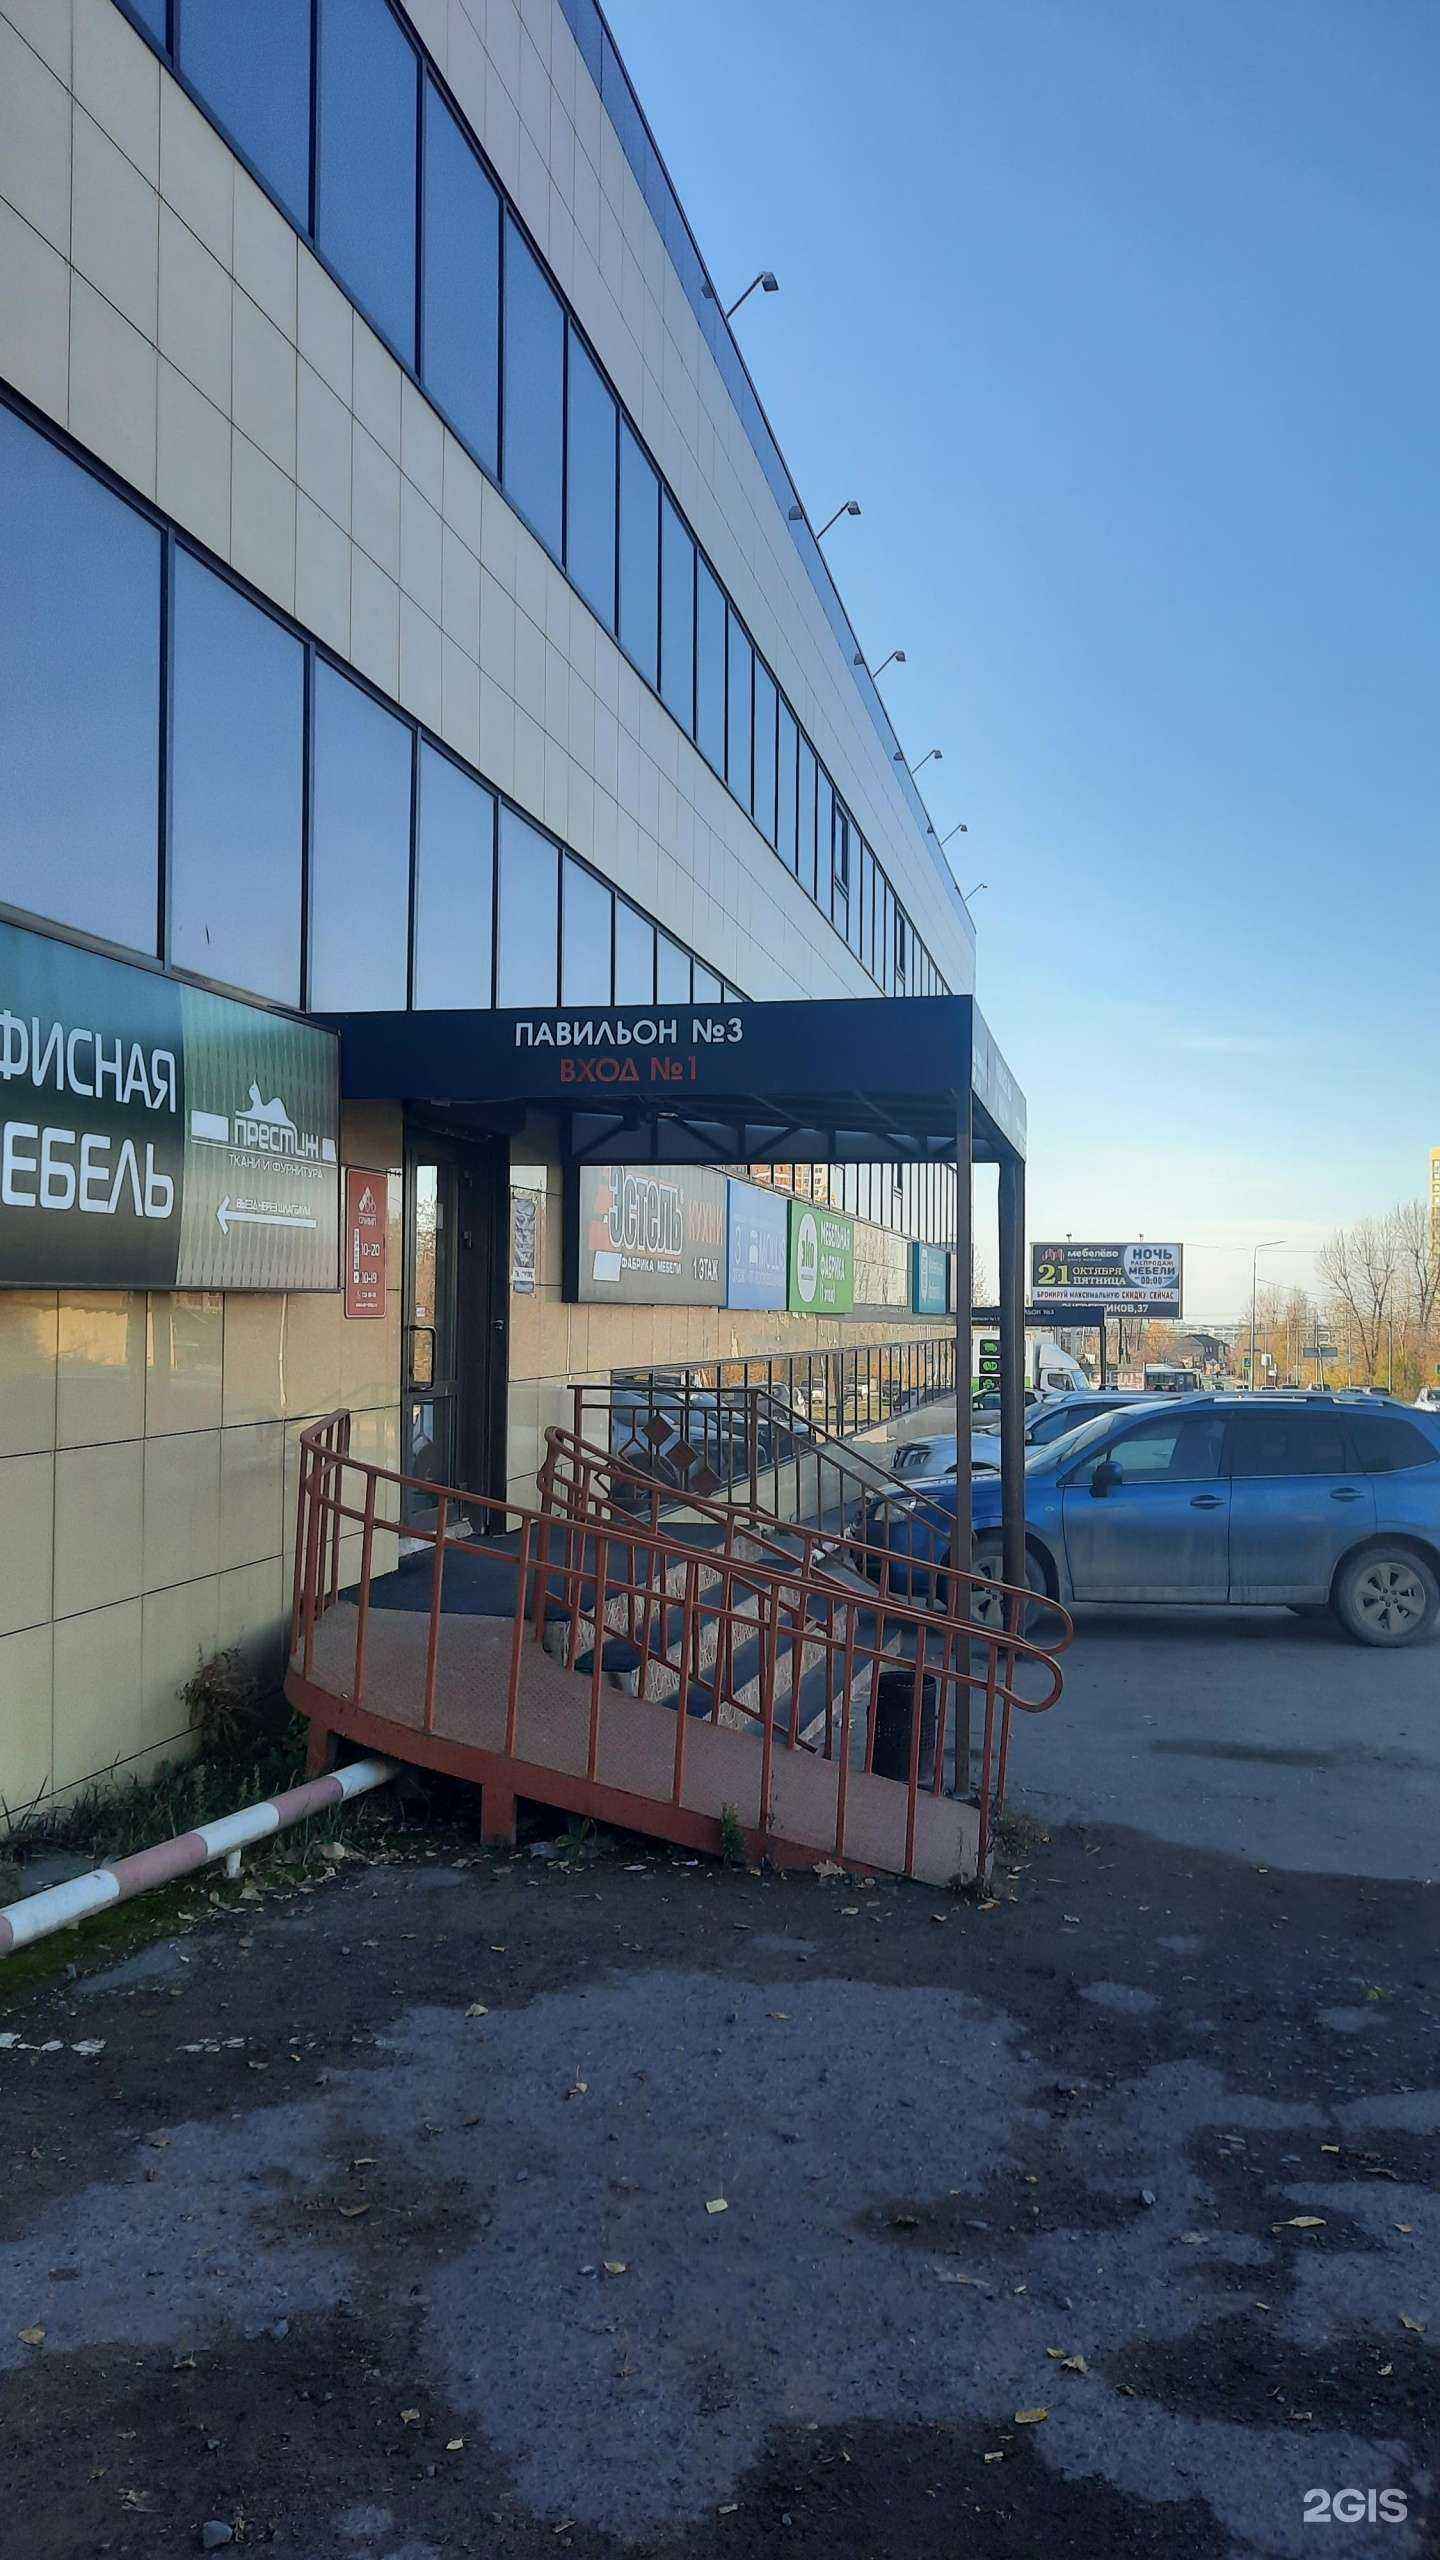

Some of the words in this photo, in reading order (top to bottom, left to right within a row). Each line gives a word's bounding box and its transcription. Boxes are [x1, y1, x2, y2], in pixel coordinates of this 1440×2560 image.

[515, 1019, 677, 1047] ПАВИЛЬОН
[692, 1017, 744, 1044] №3
[560, 1056, 641, 1083] ВХОД
[650, 1055, 697, 1081] №1
[2, 1120, 175, 1219] ЕБЕЛЬ
[228, 1153, 260, 1170] ТКАНИ
[272, 1162, 326, 1180] ФУРНИТУРА
[1133, 1249, 1173, 1260] НОЧЬ
[621, 1257, 655, 1273] ФАБРИКА
[1072, 1267, 1122, 1276] ОКТЯБРЯ
[1128, 1266, 1176, 1276] МЕБЕЛИ
[1038, 1264, 1071, 1285] 21
[1072, 1276, 1127, 1285] ПЯТНИЦА
[1121, 1290, 1147, 1300] СКИДКУ
